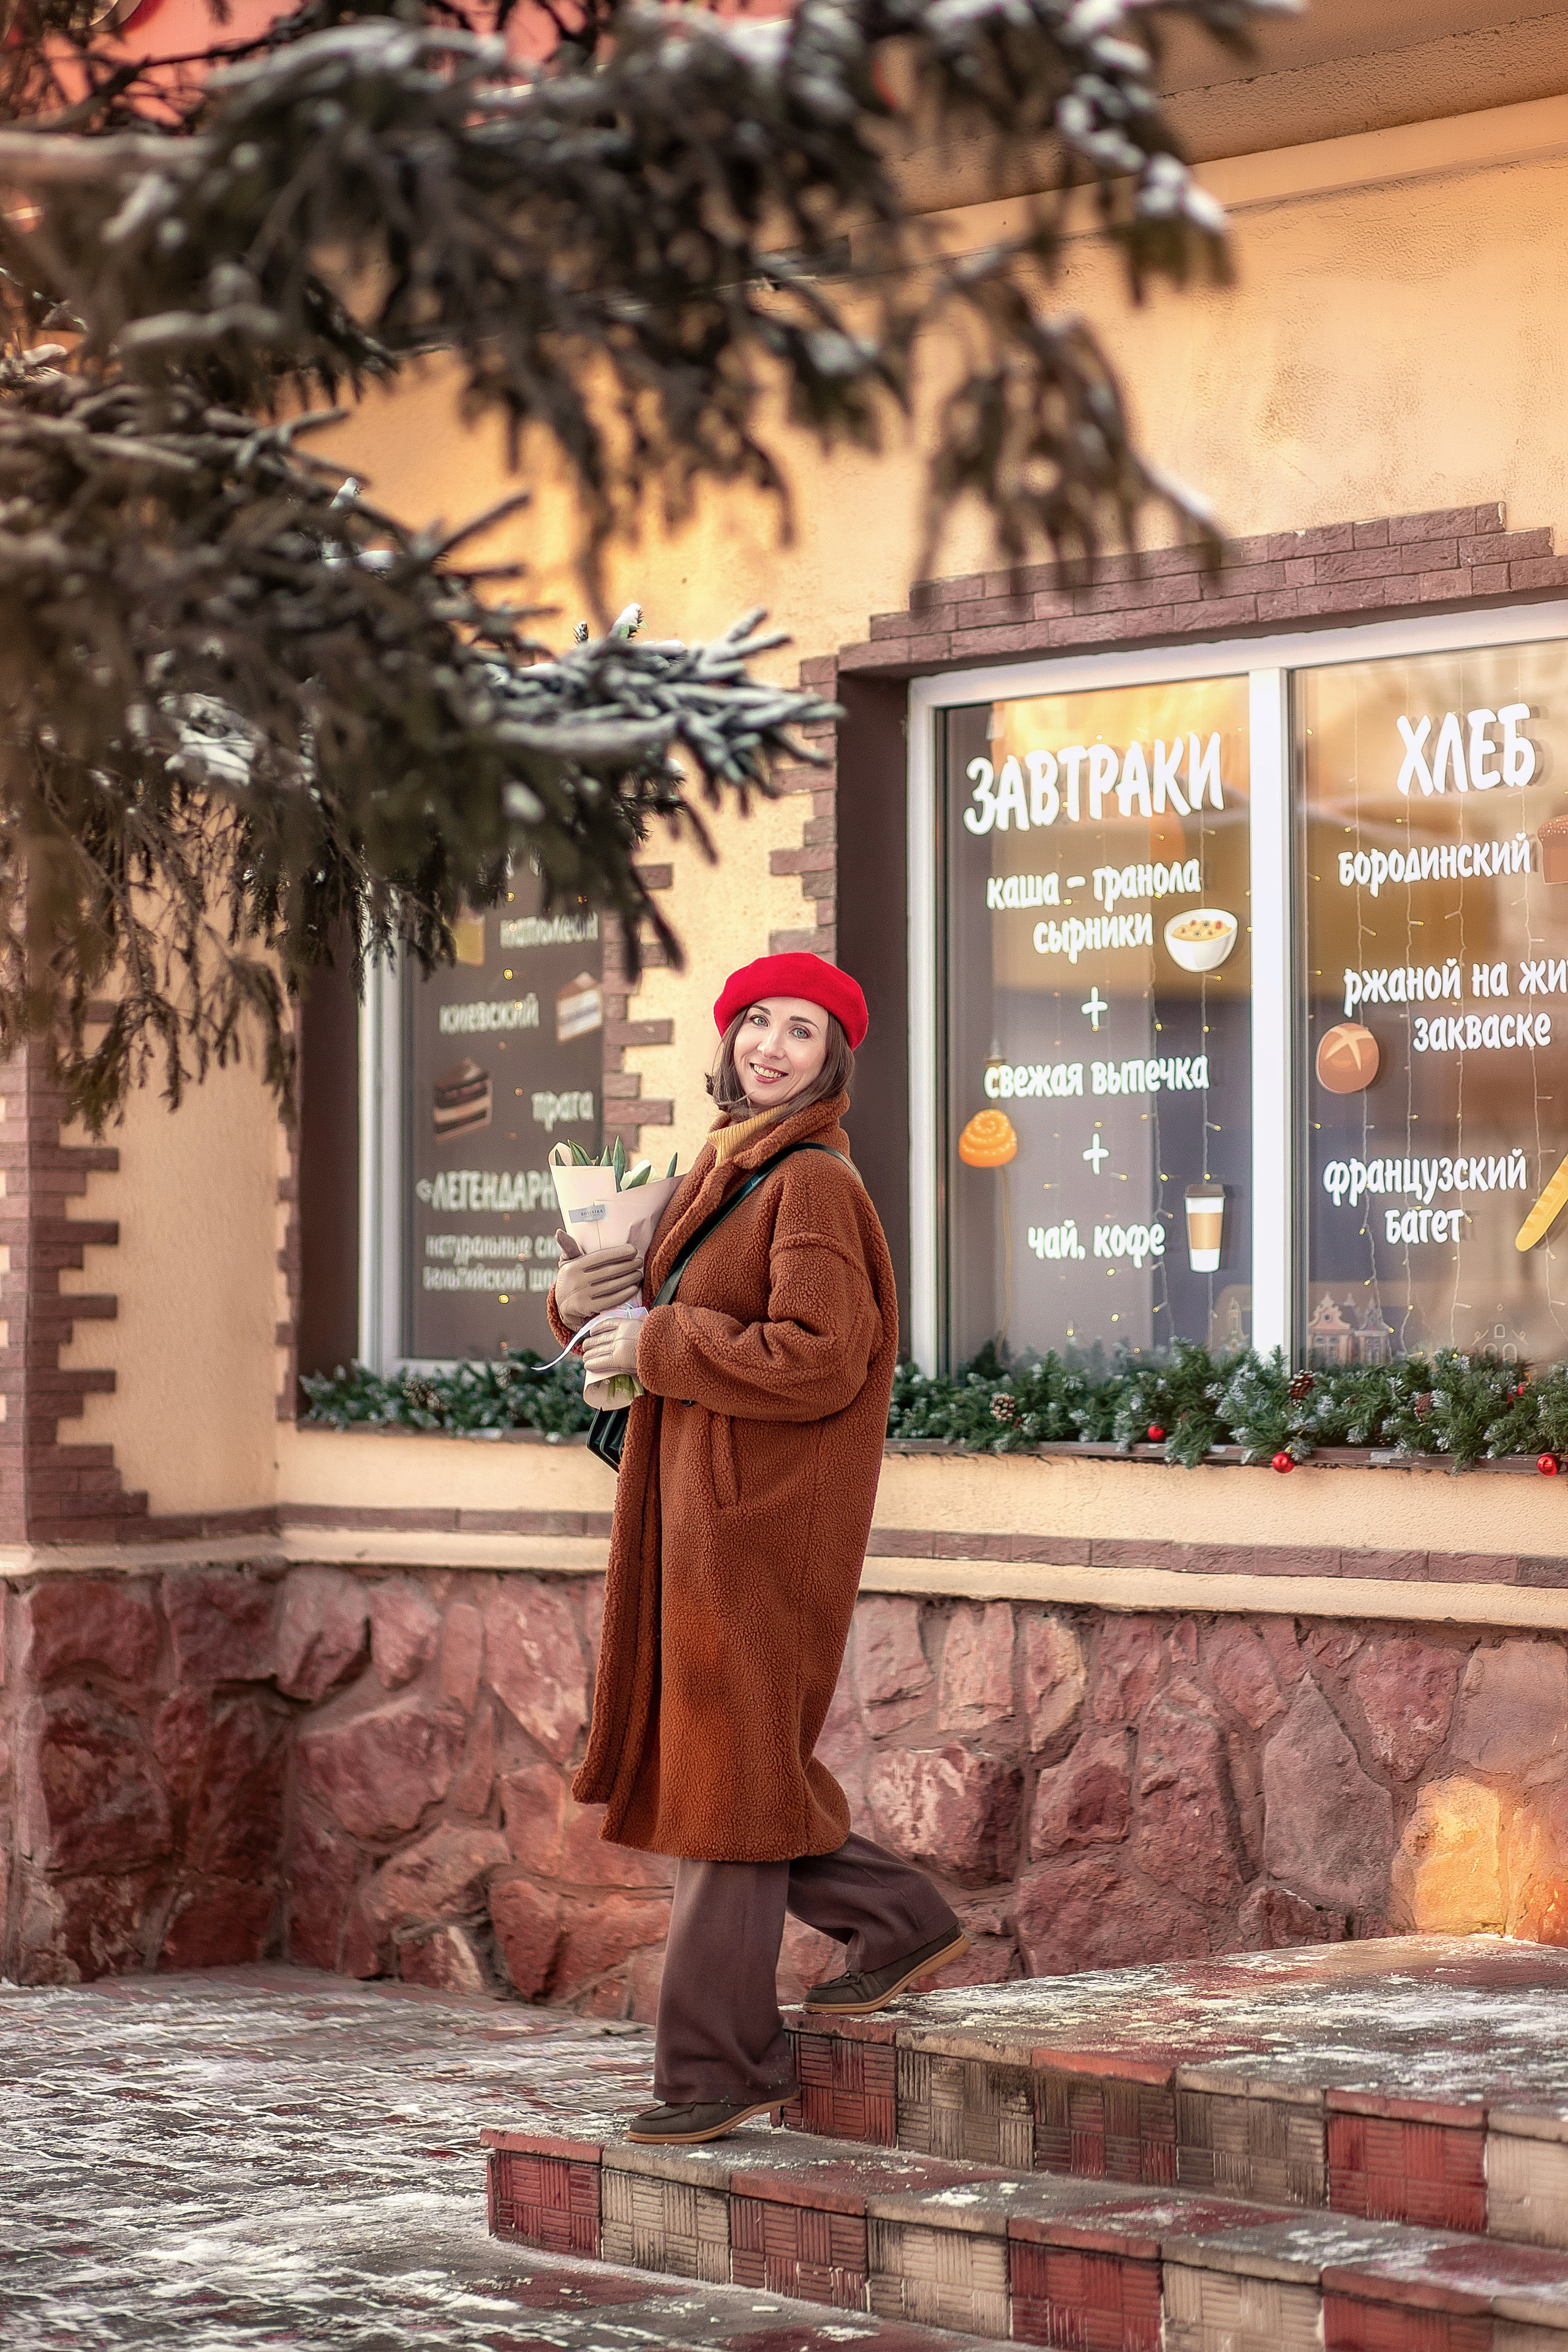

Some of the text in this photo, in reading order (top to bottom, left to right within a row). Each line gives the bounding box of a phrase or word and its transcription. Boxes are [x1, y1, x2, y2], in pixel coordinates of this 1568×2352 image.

[1396, 703, 1536, 796] ХЛЕБ
[963, 732, 1224, 835] ЗАВТРАКИ
[987, 872, 1061, 910] каша
[1092, 858, 1202, 913] гранола
[1033, 913, 1153, 964] сырники
[1343, 957, 1568, 1017] ржаной на жи
[1412, 1012, 1552, 1052] закваске
[984, 1055, 1210, 1098] свежая выпечка
[531, 1090, 594, 1132] прага
[415, 1169, 559, 1212] «ЛЕГЕНДАРН
[1323, 1148, 1528, 1207] французский
[1027, 1219, 1166, 1268] чай, кофе
[1384, 1208, 1464, 1244] багет
[528, 1267, 557, 1292] шо
